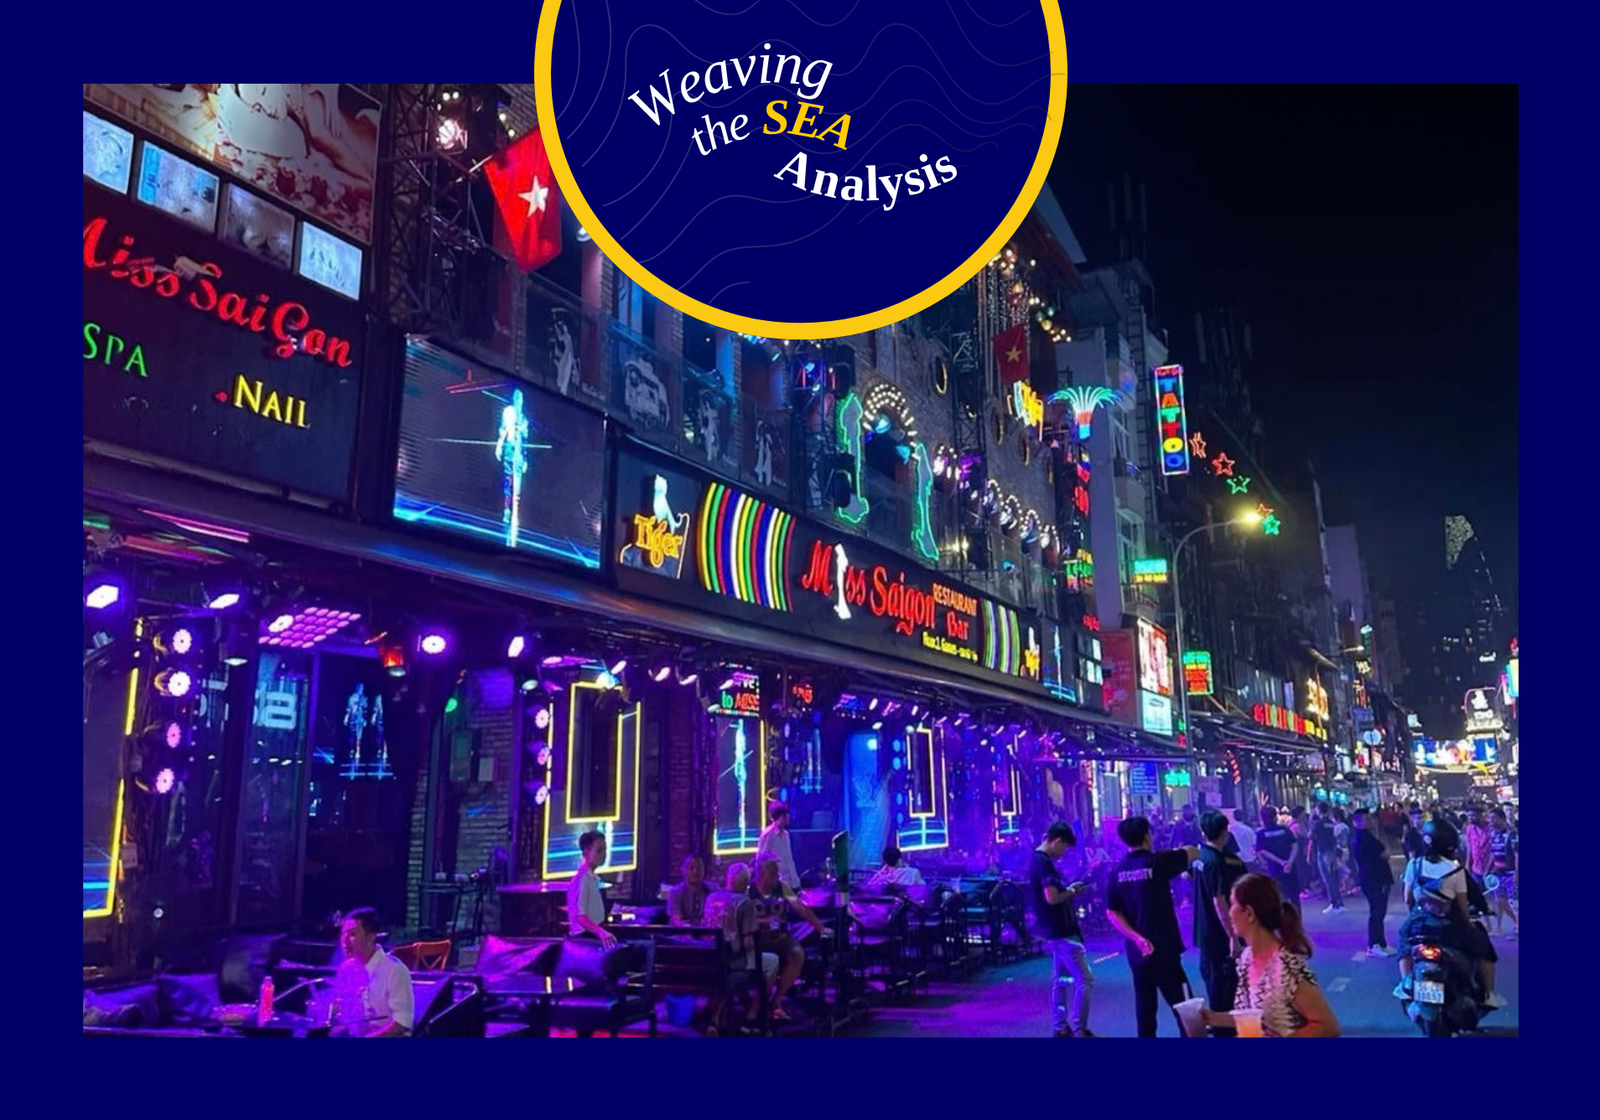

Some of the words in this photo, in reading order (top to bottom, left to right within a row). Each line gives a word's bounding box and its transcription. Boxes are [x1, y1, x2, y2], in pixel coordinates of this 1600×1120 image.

[83, 322, 148, 378] SPA
[234, 373, 311, 428] NAIL
[1159, 376, 1186, 469] TATTOO
[634, 514, 683, 568] Tiger
[870, 565, 936, 636] Saigon
[932, 582, 978, 618] RESTAURANT
[946, 610, 969, 641] Bar
[1118, 867, 1153, 883] SECURITY
